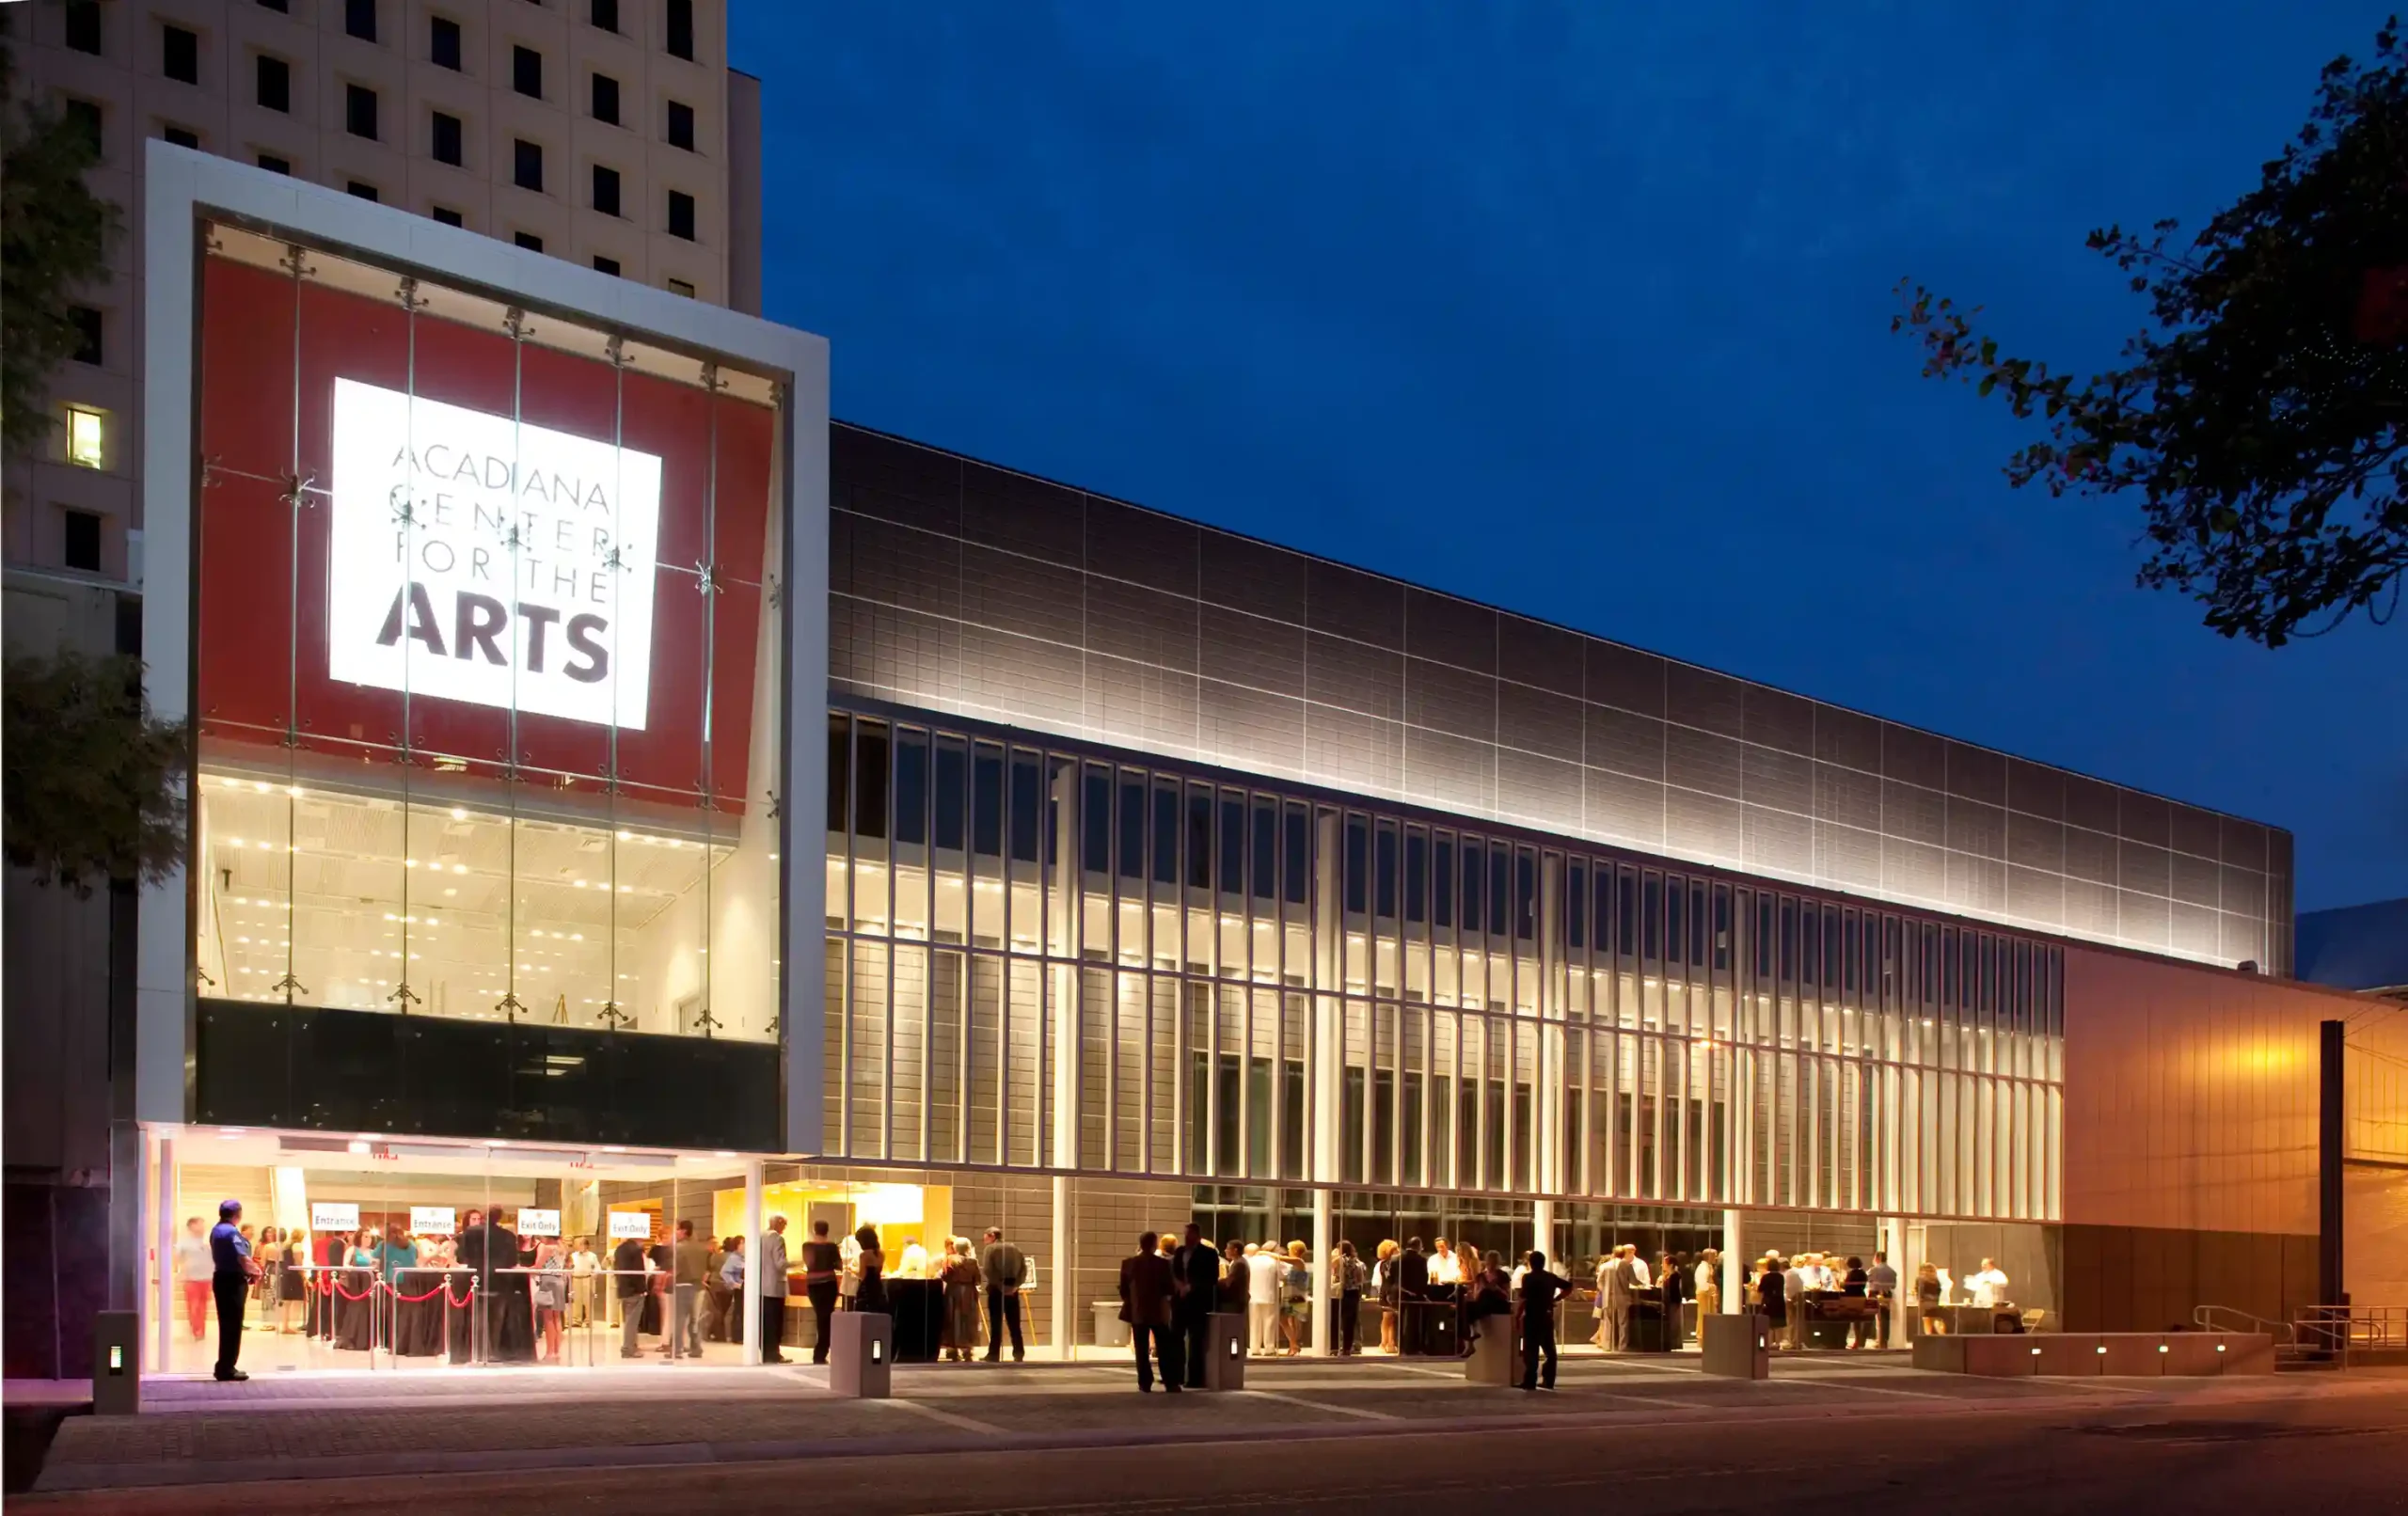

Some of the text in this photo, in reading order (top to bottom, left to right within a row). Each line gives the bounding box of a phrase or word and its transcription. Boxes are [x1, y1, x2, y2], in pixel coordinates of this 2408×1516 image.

[392, 444, 610, 515] ACADIANA
[389, 483, 610, 557] CENTER
[397, 531, 607, 603] FOR THE
[375, 581, 609, 684] ARTS
[315, 1215, 355, 1225] Entrance
[414, 1219, 452, 1229] Entrance
[521, 1221, 557, 1231] Exit Only
[629, 1224, 647, 1234] Only
